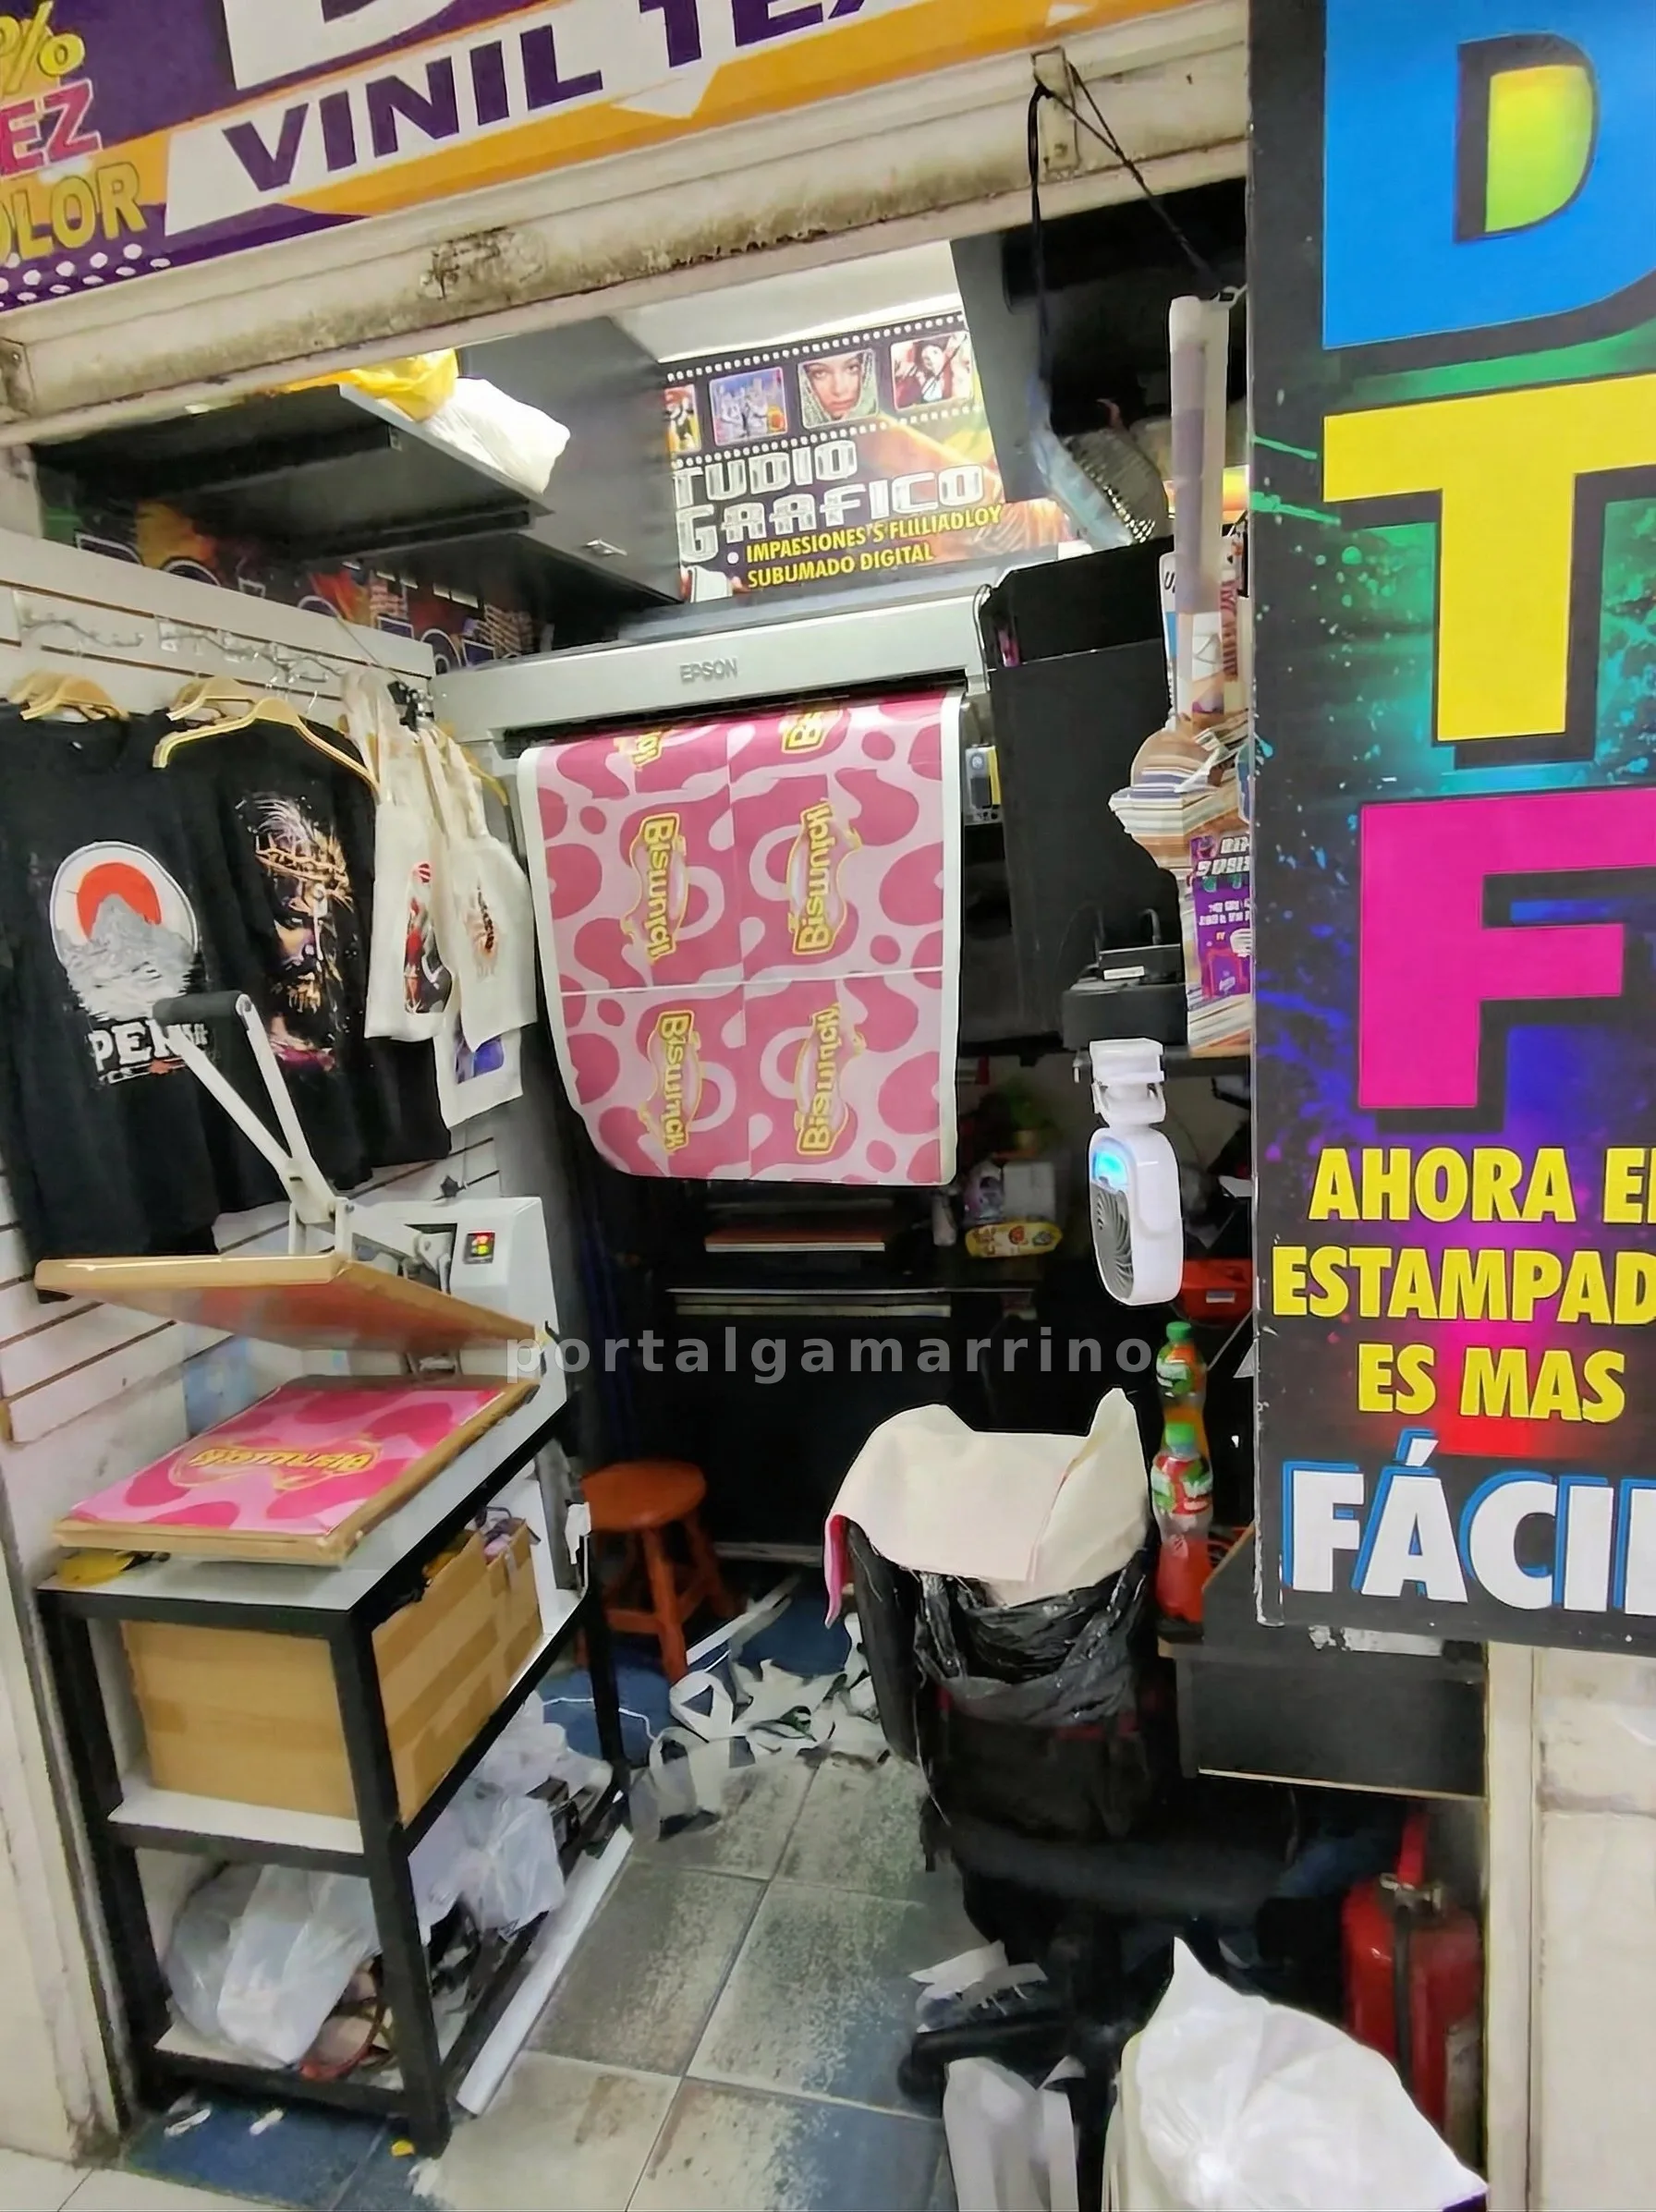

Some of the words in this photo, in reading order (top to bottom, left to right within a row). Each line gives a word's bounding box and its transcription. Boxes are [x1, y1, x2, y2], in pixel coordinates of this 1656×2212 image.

[223, 25, 603, 192] VINIL
[639, 0, 865, 67] TE
[0, 161, 147, 261] LOR
[859, 542, 934, 571] DIGITAL
[679, 657, 738, 684] EPSON
[1308, 1147, 1577, 1223] AHORA
[1602, 1147, 1656, 1224] E
[1358, 1343, 1437, 1416] ES
[1460, 1346, 1626, 1423] MAS
